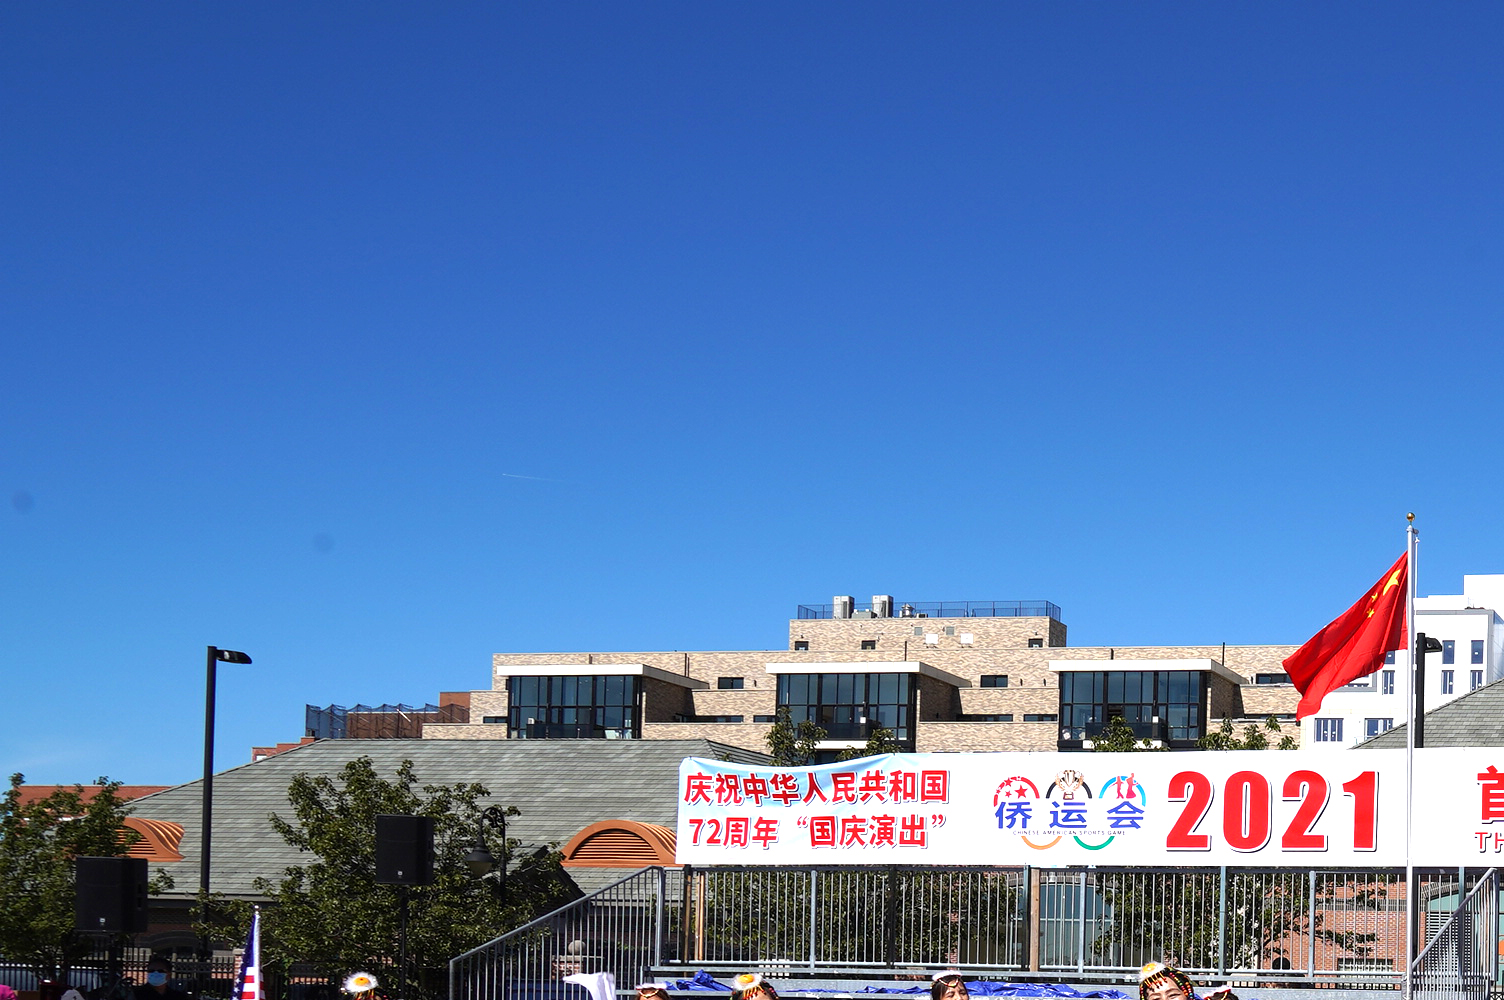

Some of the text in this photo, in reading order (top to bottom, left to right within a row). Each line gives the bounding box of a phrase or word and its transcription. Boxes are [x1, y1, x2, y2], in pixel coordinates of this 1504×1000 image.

[684, 769, 949, 806] 庆祝中华人民共和国
[994, 800, 1145, 830] 侨运会
[1166, 769, 1378, 852] 2021
